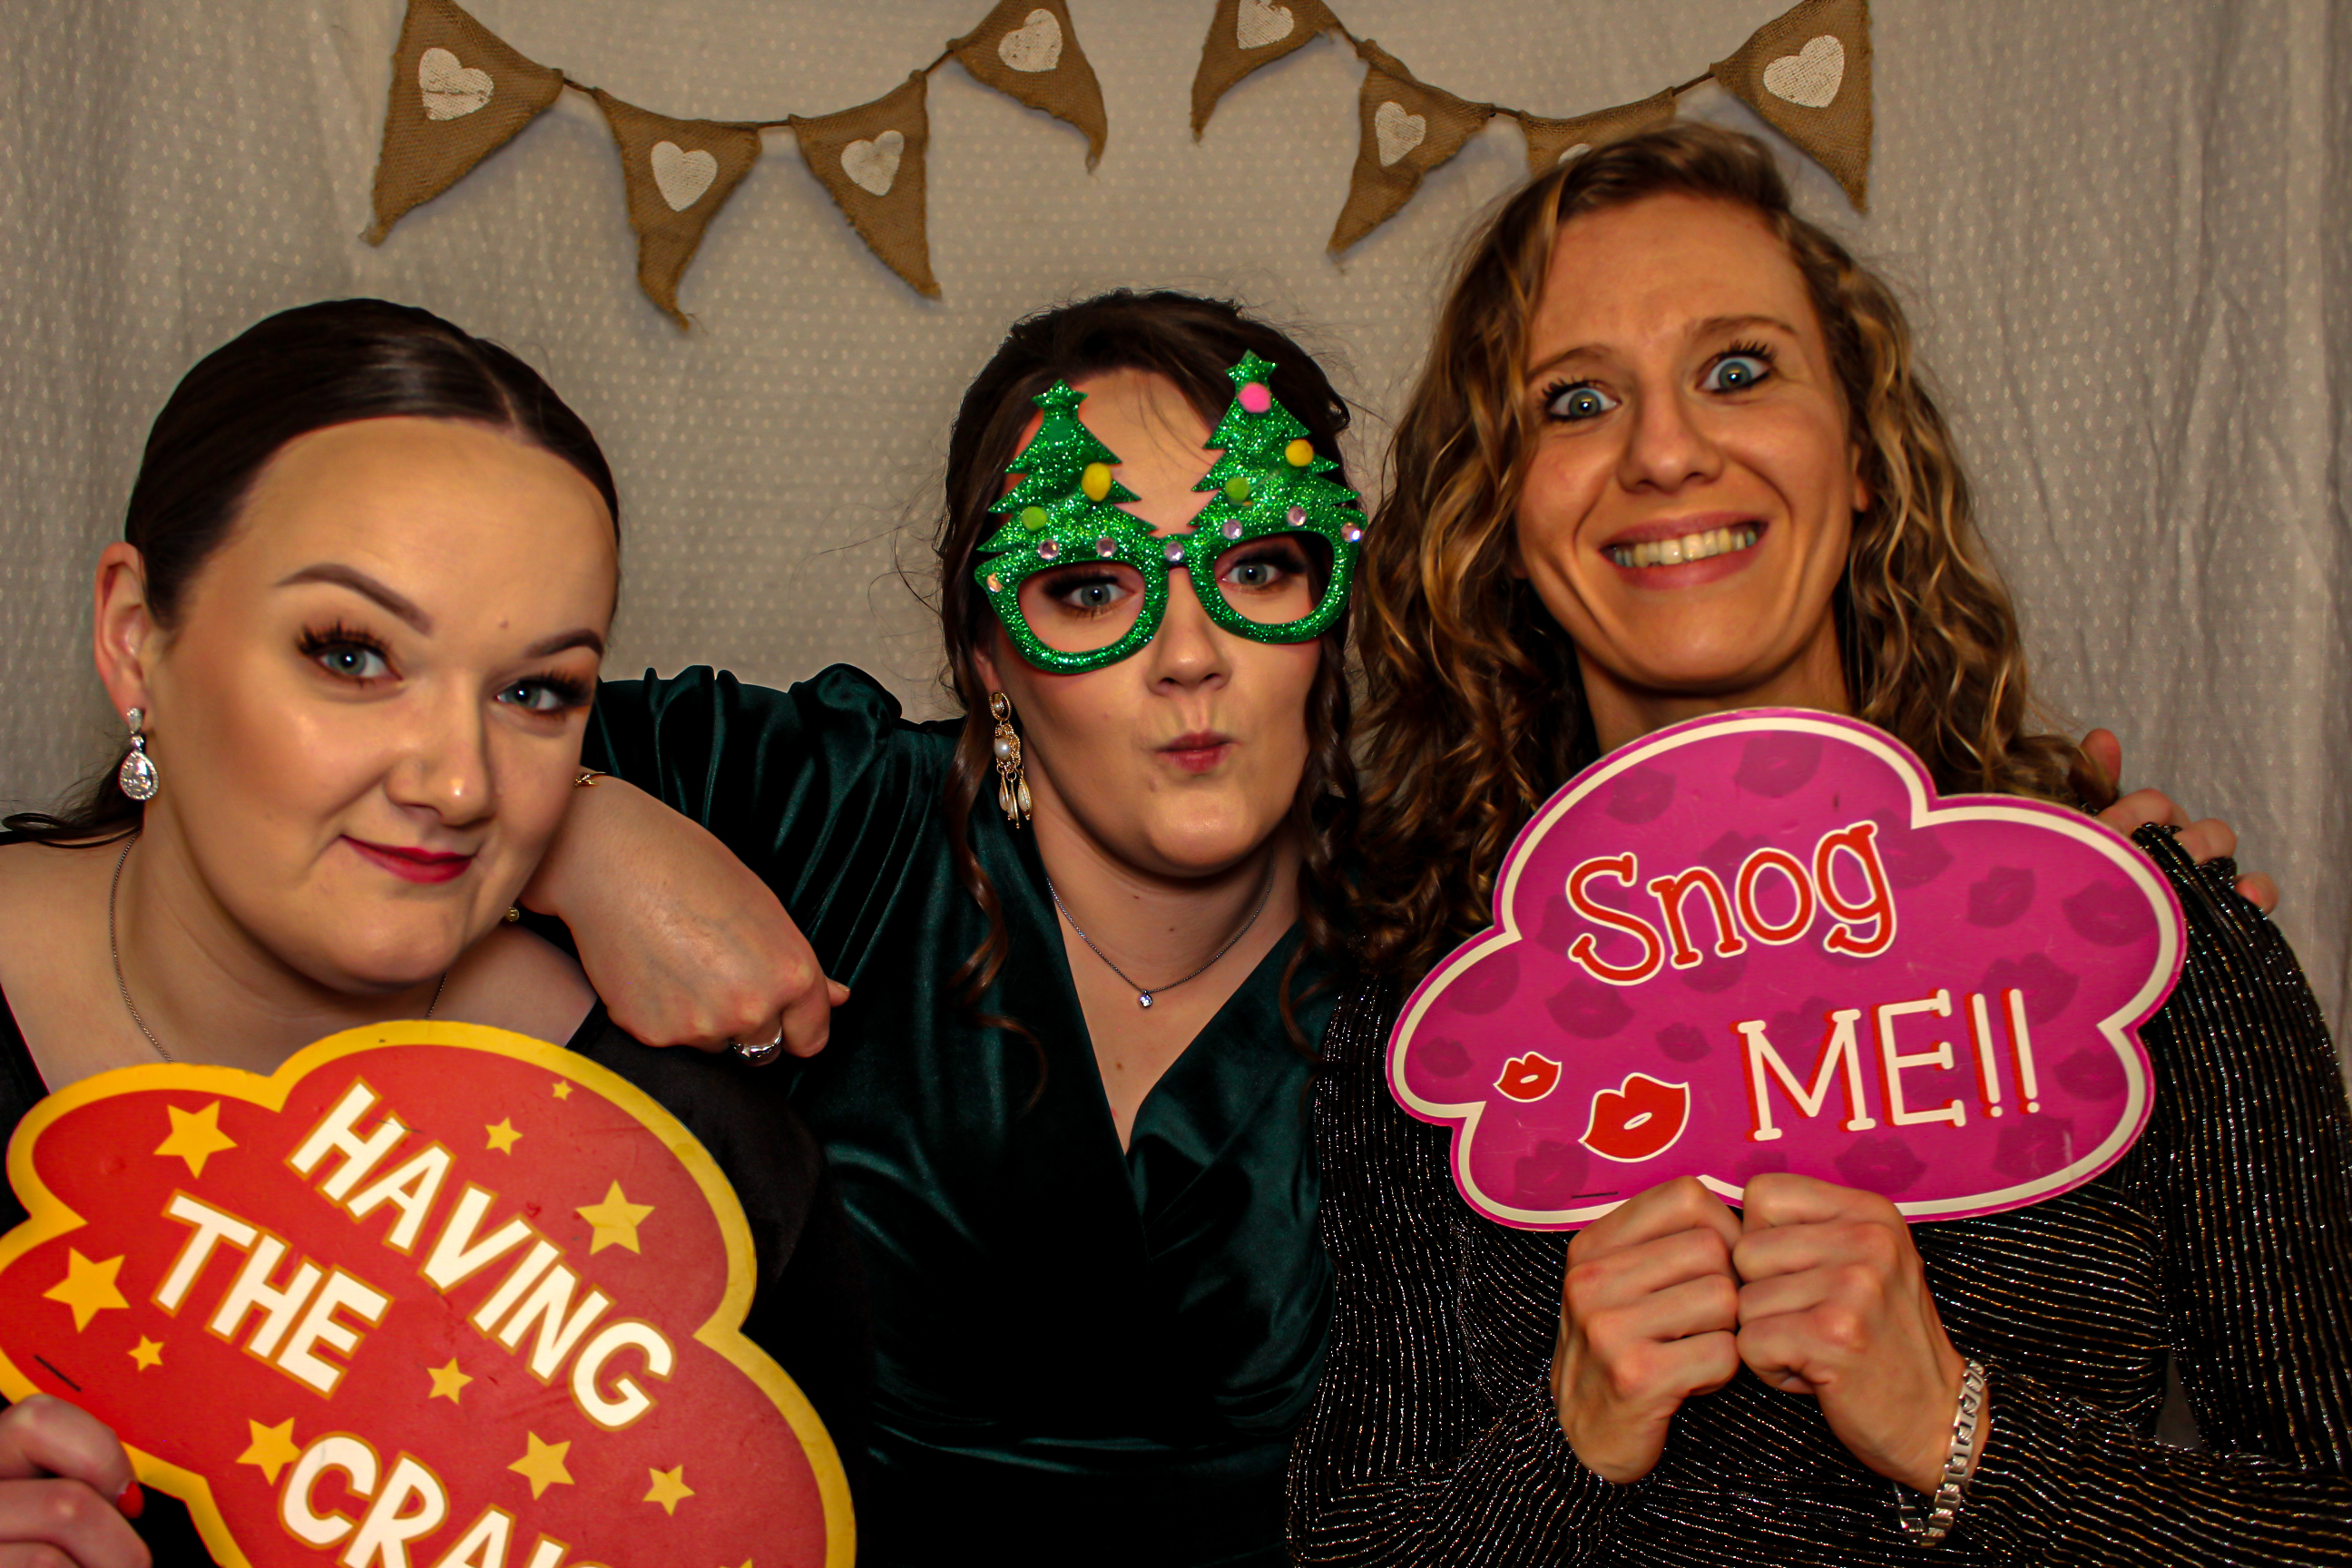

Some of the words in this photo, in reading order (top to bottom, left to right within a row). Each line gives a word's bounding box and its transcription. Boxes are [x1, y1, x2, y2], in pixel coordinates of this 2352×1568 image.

[1566, 820, 1897, 985] Snog
[1730, 988, 2040, 1141] ME!!
[151, 1190, 394, 1398] THE
[284, 1076, 676, 1431] HAVING
[278, 1431, 622, 1568] CRA
